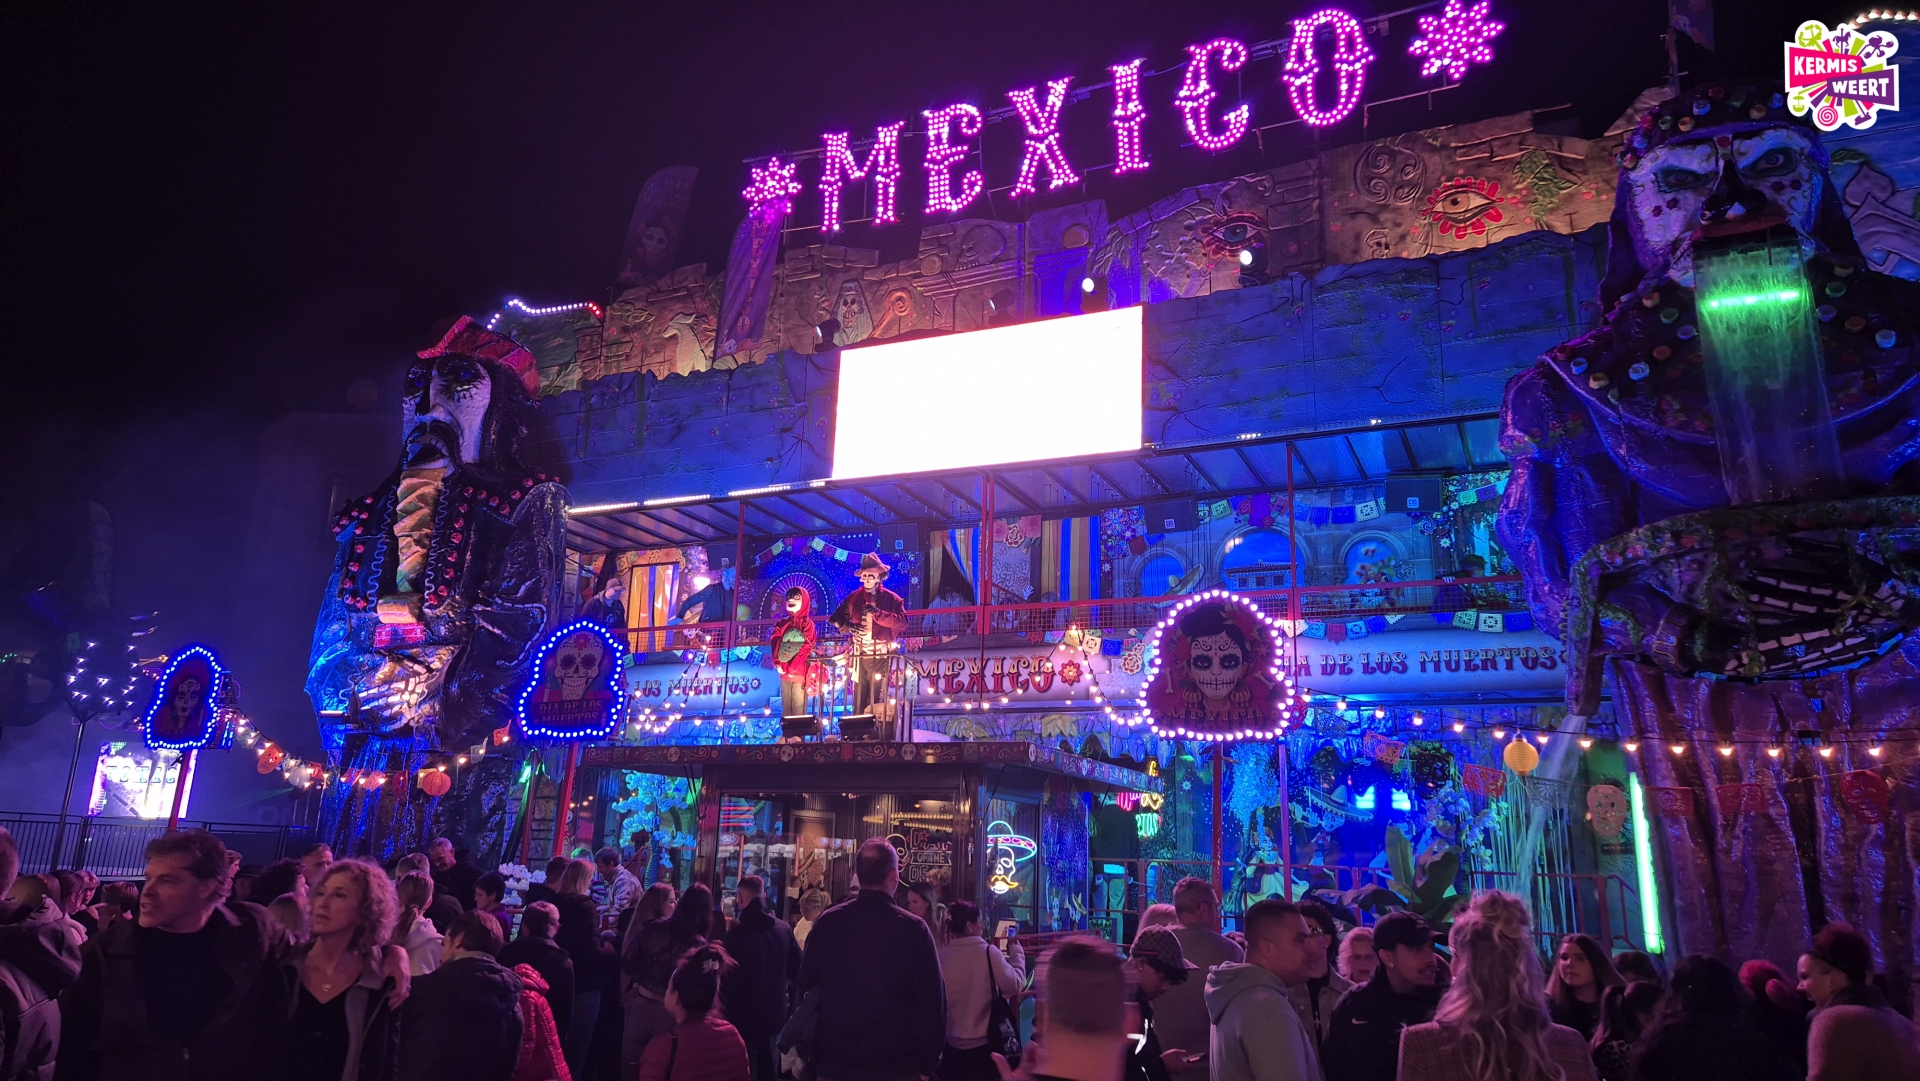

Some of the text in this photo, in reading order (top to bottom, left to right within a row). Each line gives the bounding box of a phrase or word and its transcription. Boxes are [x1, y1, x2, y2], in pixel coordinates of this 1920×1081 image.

[818, 8, 1377, 235] MEXICO
[1320, 653, 1354, 676] DE
[1361, 651, 1409, 675] LOS
[1418, 646, 1558, 673] MUERTOS
[914, 654, 1056, 695] MEXICO
[633, 679, 662, 698] LOS
[539, 699, 604, 715] DIA DE LOS
[541, 711, 599, 726] MUERTOS
